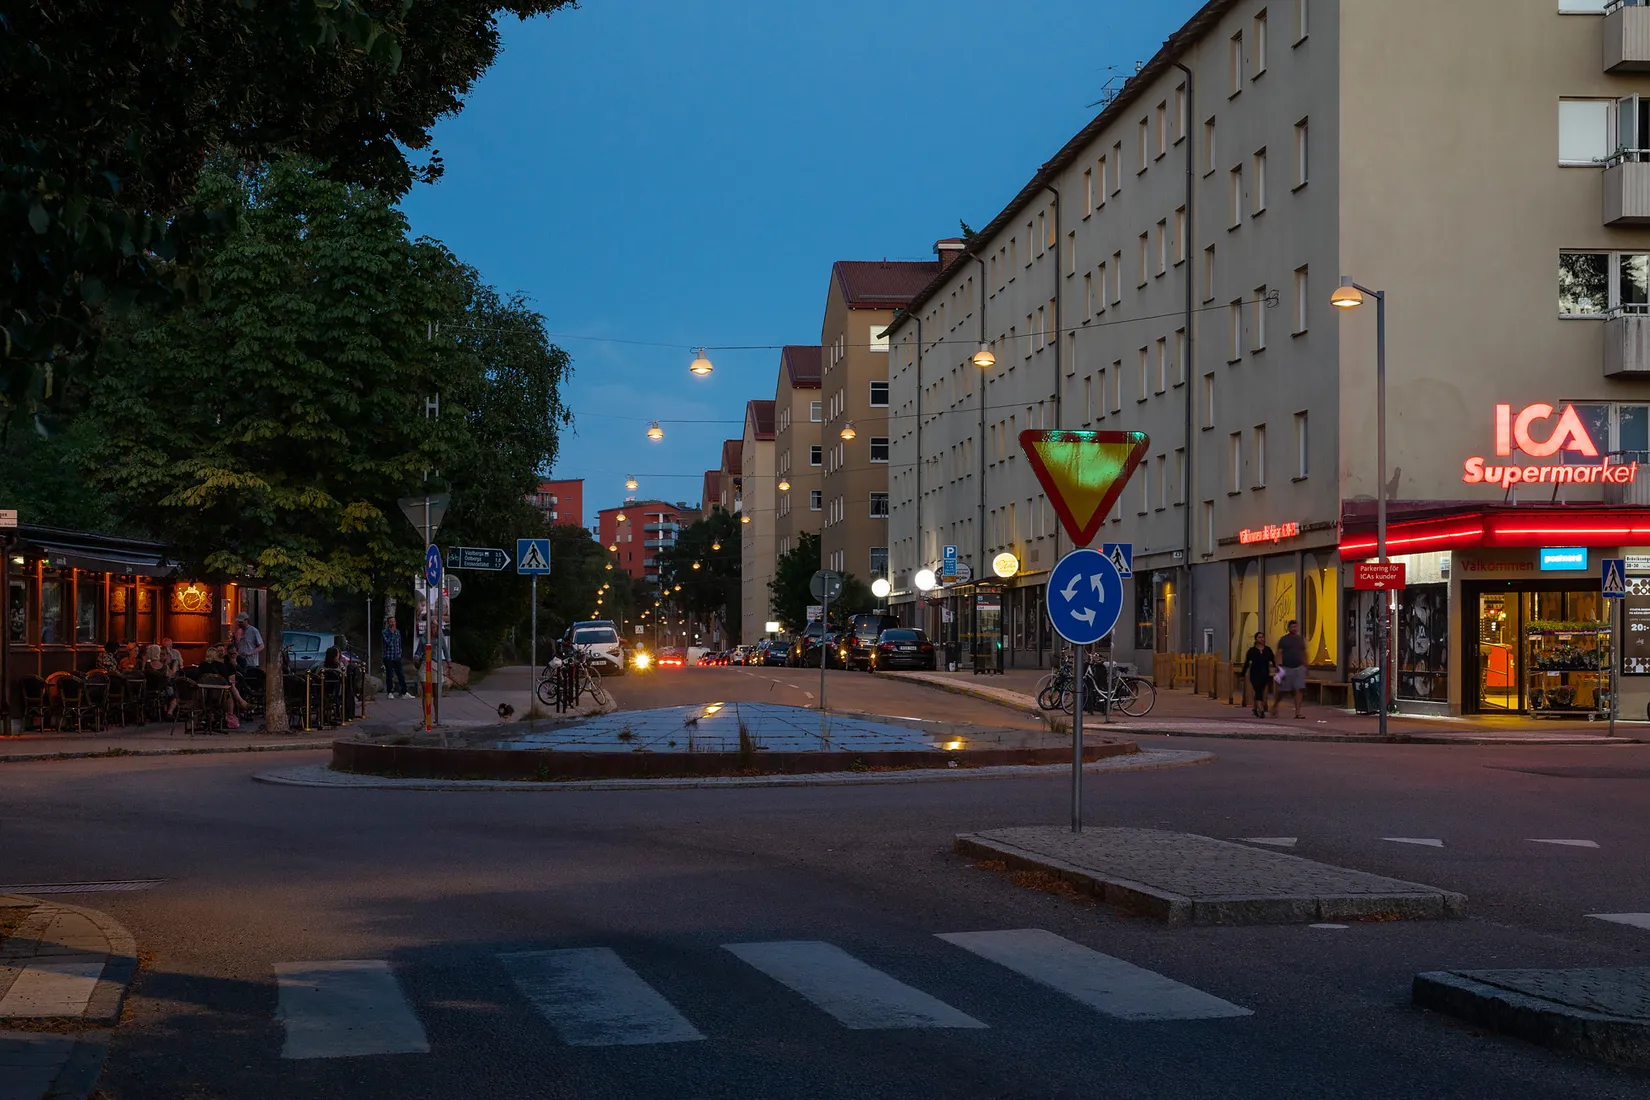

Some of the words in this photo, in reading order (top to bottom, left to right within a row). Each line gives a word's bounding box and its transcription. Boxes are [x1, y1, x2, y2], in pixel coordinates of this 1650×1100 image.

[1495, 403, 1599, 457] ICA
[1462, 455, 1638, 489] Supermarket
[946, 547, 955, 558] P
[1544, 553, 1583, 564] postnord
[1360, 565, 1389, 573] Parkering
